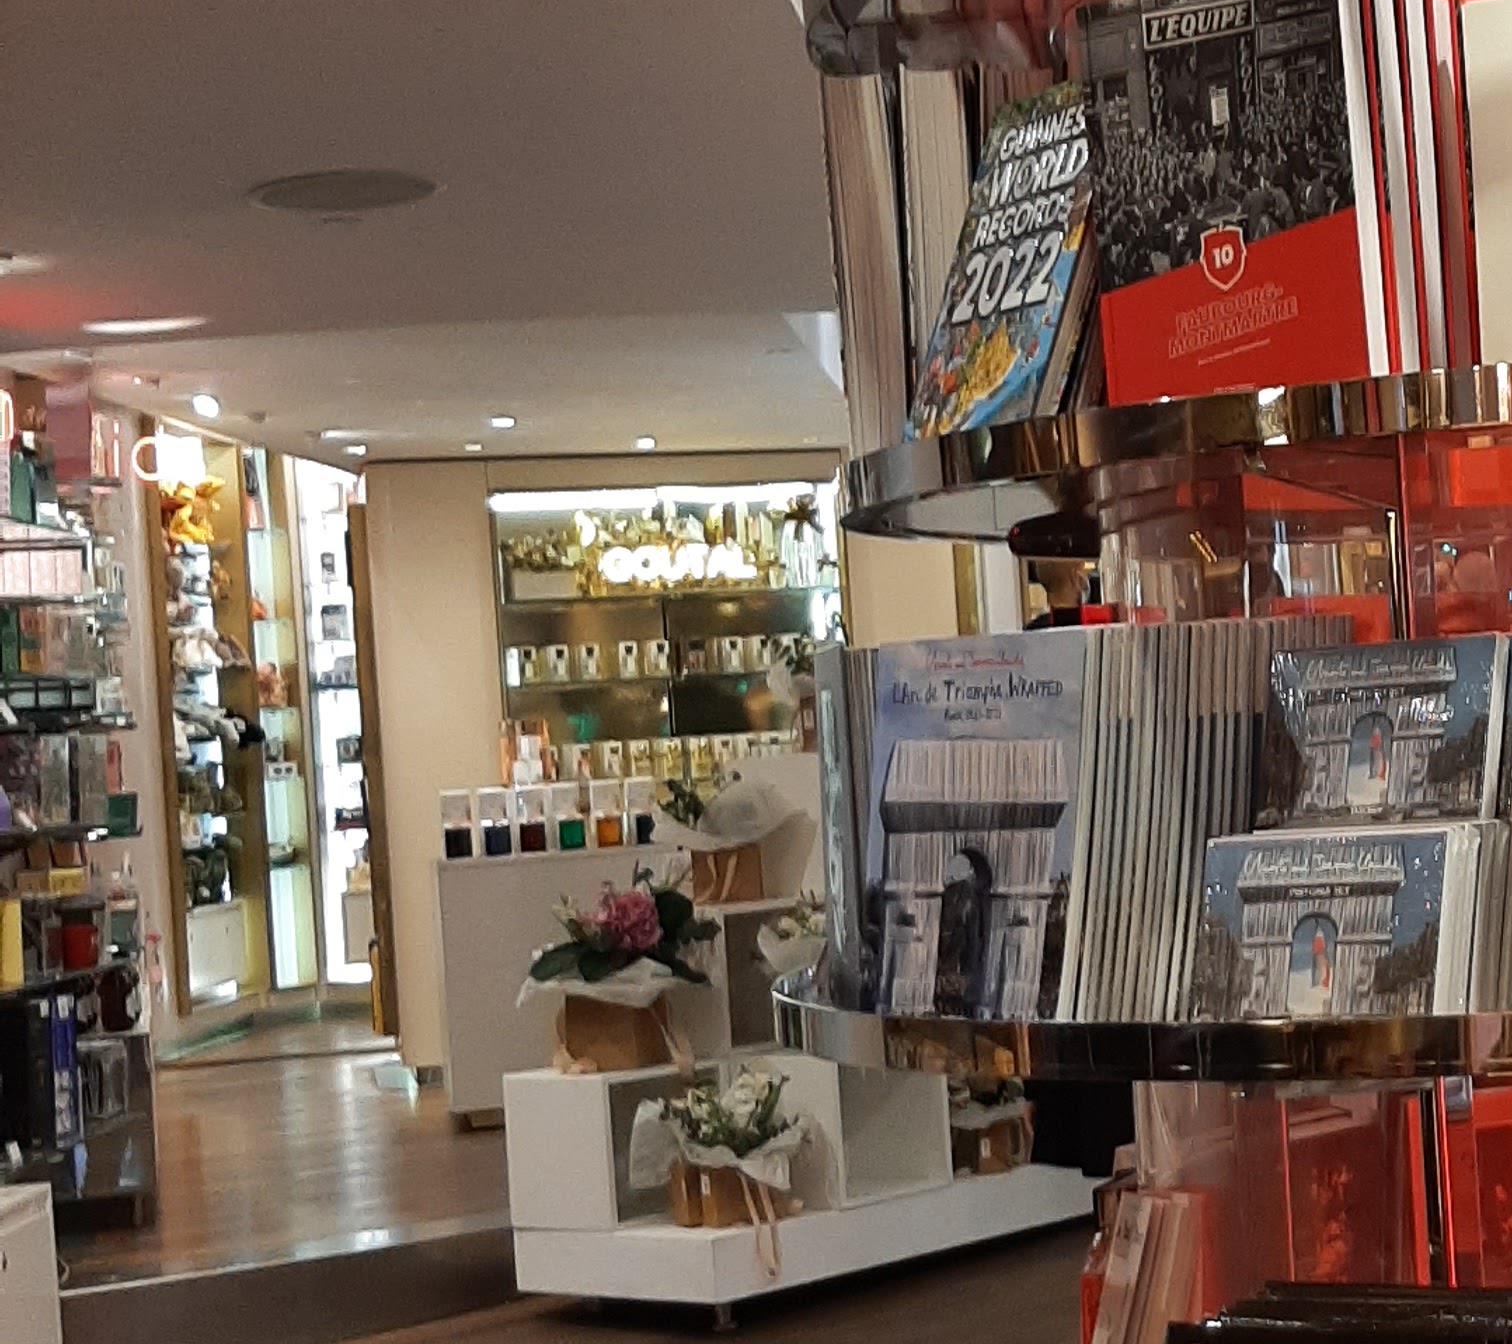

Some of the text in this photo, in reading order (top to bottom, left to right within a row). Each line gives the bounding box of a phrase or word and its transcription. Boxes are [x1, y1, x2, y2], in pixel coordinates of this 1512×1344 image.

[1150, 3, 1250, 43] L'EQUIPE
[987, 139, 1090, 209] WORLD
[973, 188, 1076, 248] RECORDS
[953, 232, 1064, 325] 2022
[1213, 244, 1234, 269] 10
